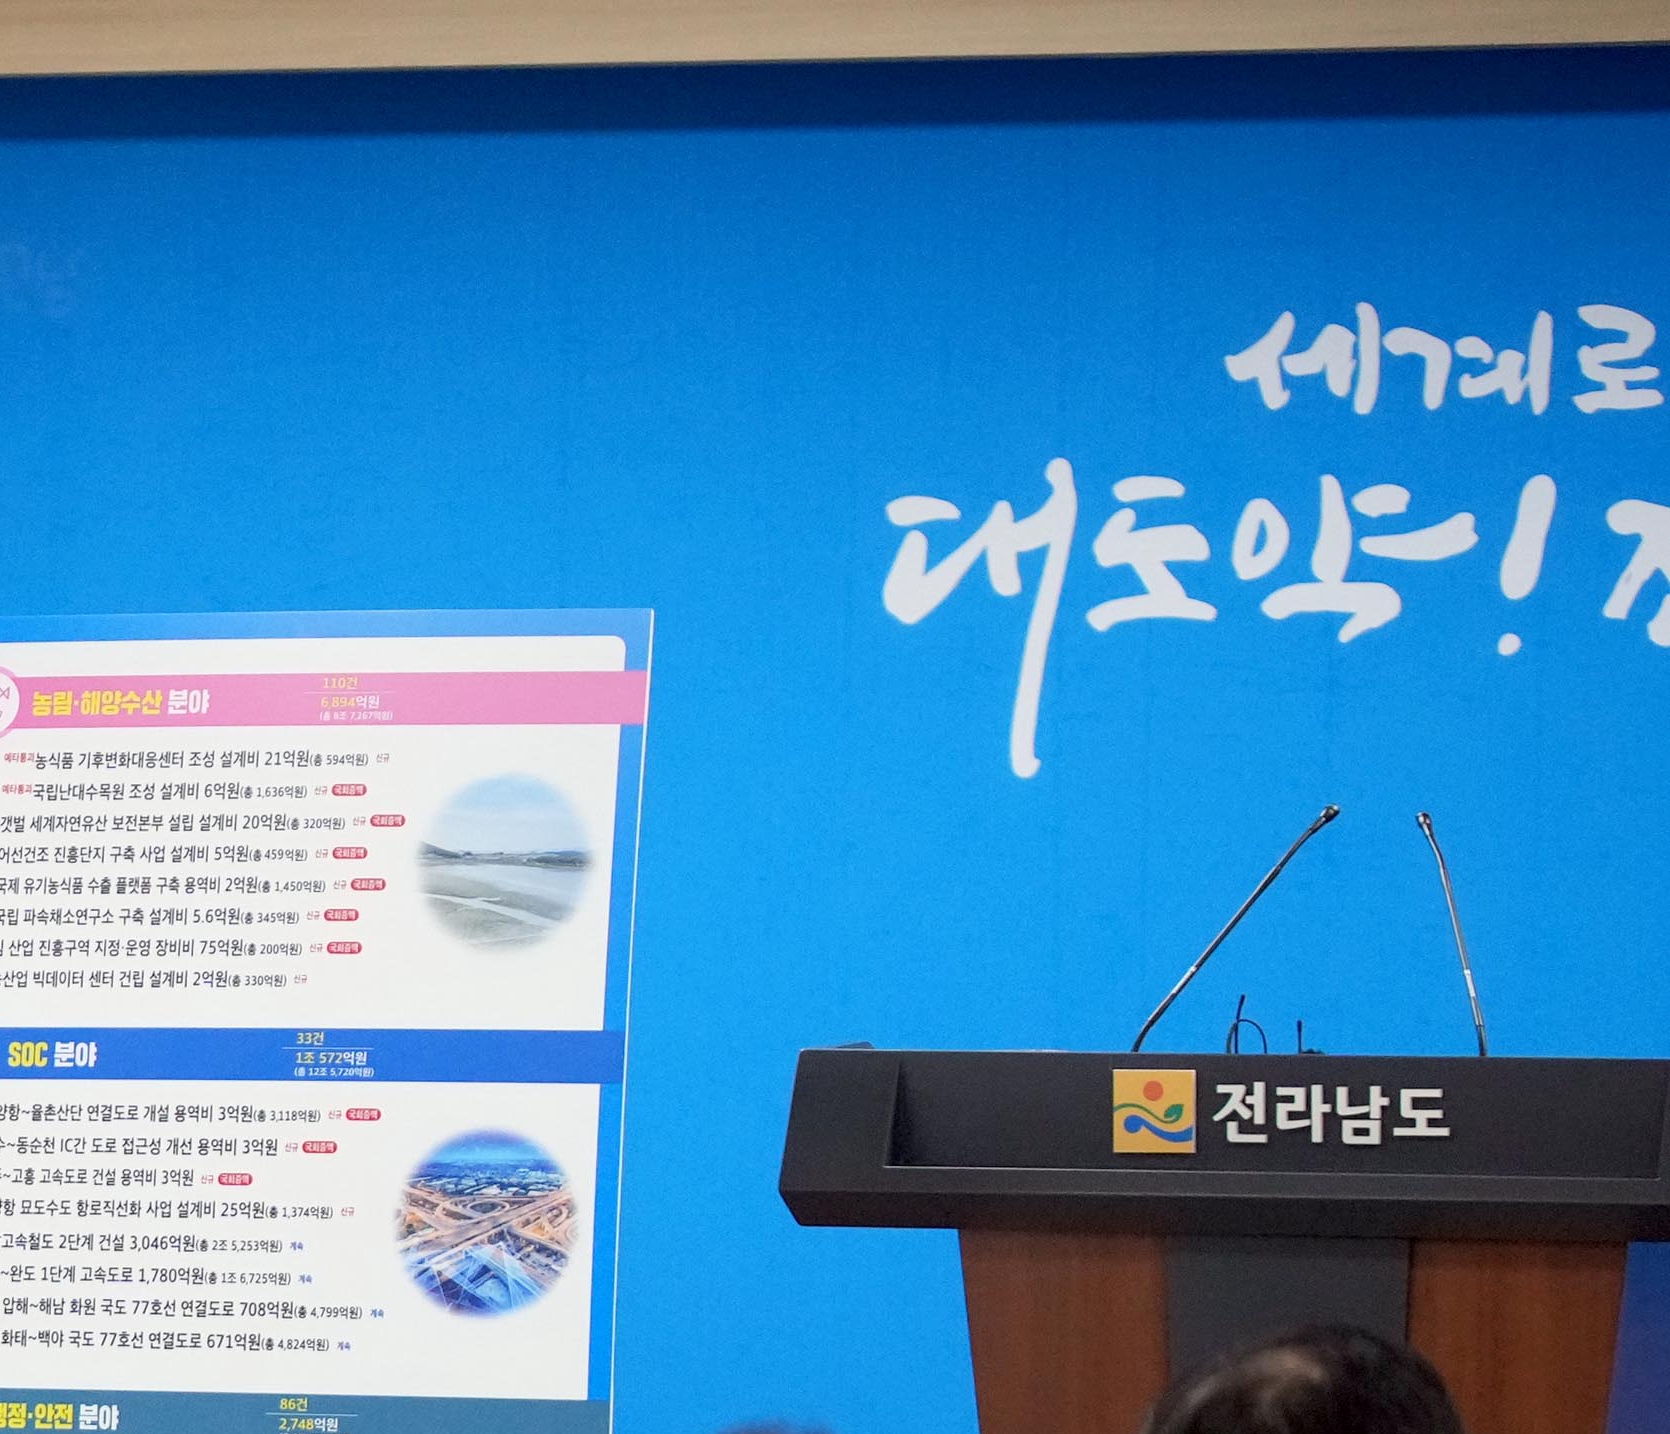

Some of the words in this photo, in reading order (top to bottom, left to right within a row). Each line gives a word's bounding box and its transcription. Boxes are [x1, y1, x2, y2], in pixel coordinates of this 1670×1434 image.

[882, 455, 1557, 778] 대도약!
[323, 677, 357, 689] 110건
[168, 689, 210, 715] 분야
[33, 970, 84, 987] 빅데이터
[89, 971, 114, 987] 센터
[120, 971, 144, 988] 건립
[150, 971, 187, 988] 설계비
[296, 1032, 324, 1045] 33건
[8, 1041, 48, 1068] SOC
[53, 1042, 97, 1068] 분야
[296, 1051, 315, 1065] 1조
[319, 1051, 367, 1065] 572억원
[1212, 1080, 1450, 1146] 전라남도
[61, 1138, 86, 1154] IC간
[91, 1138, 117, 1152] 도로
[122, 1138, 161, 1155] 접근성
[166, 1138, 192, 1155] 개선
[198, 1139, 236, 1155] 용역비
[243, 1139, 277, 1156] 3억원
[40, 1169, 87, 1184] 고속도로
[93, 1169, 115, 1186] 건설
[121, 1169, 156, 1186] 용역비
[162, 1169, 193, 1186] 3억원
[280, 1397, 308, 1411] 86건
[79, 1404, 119, 1430] 분야
[279, 1418, 338, 1432] 2,748억원
